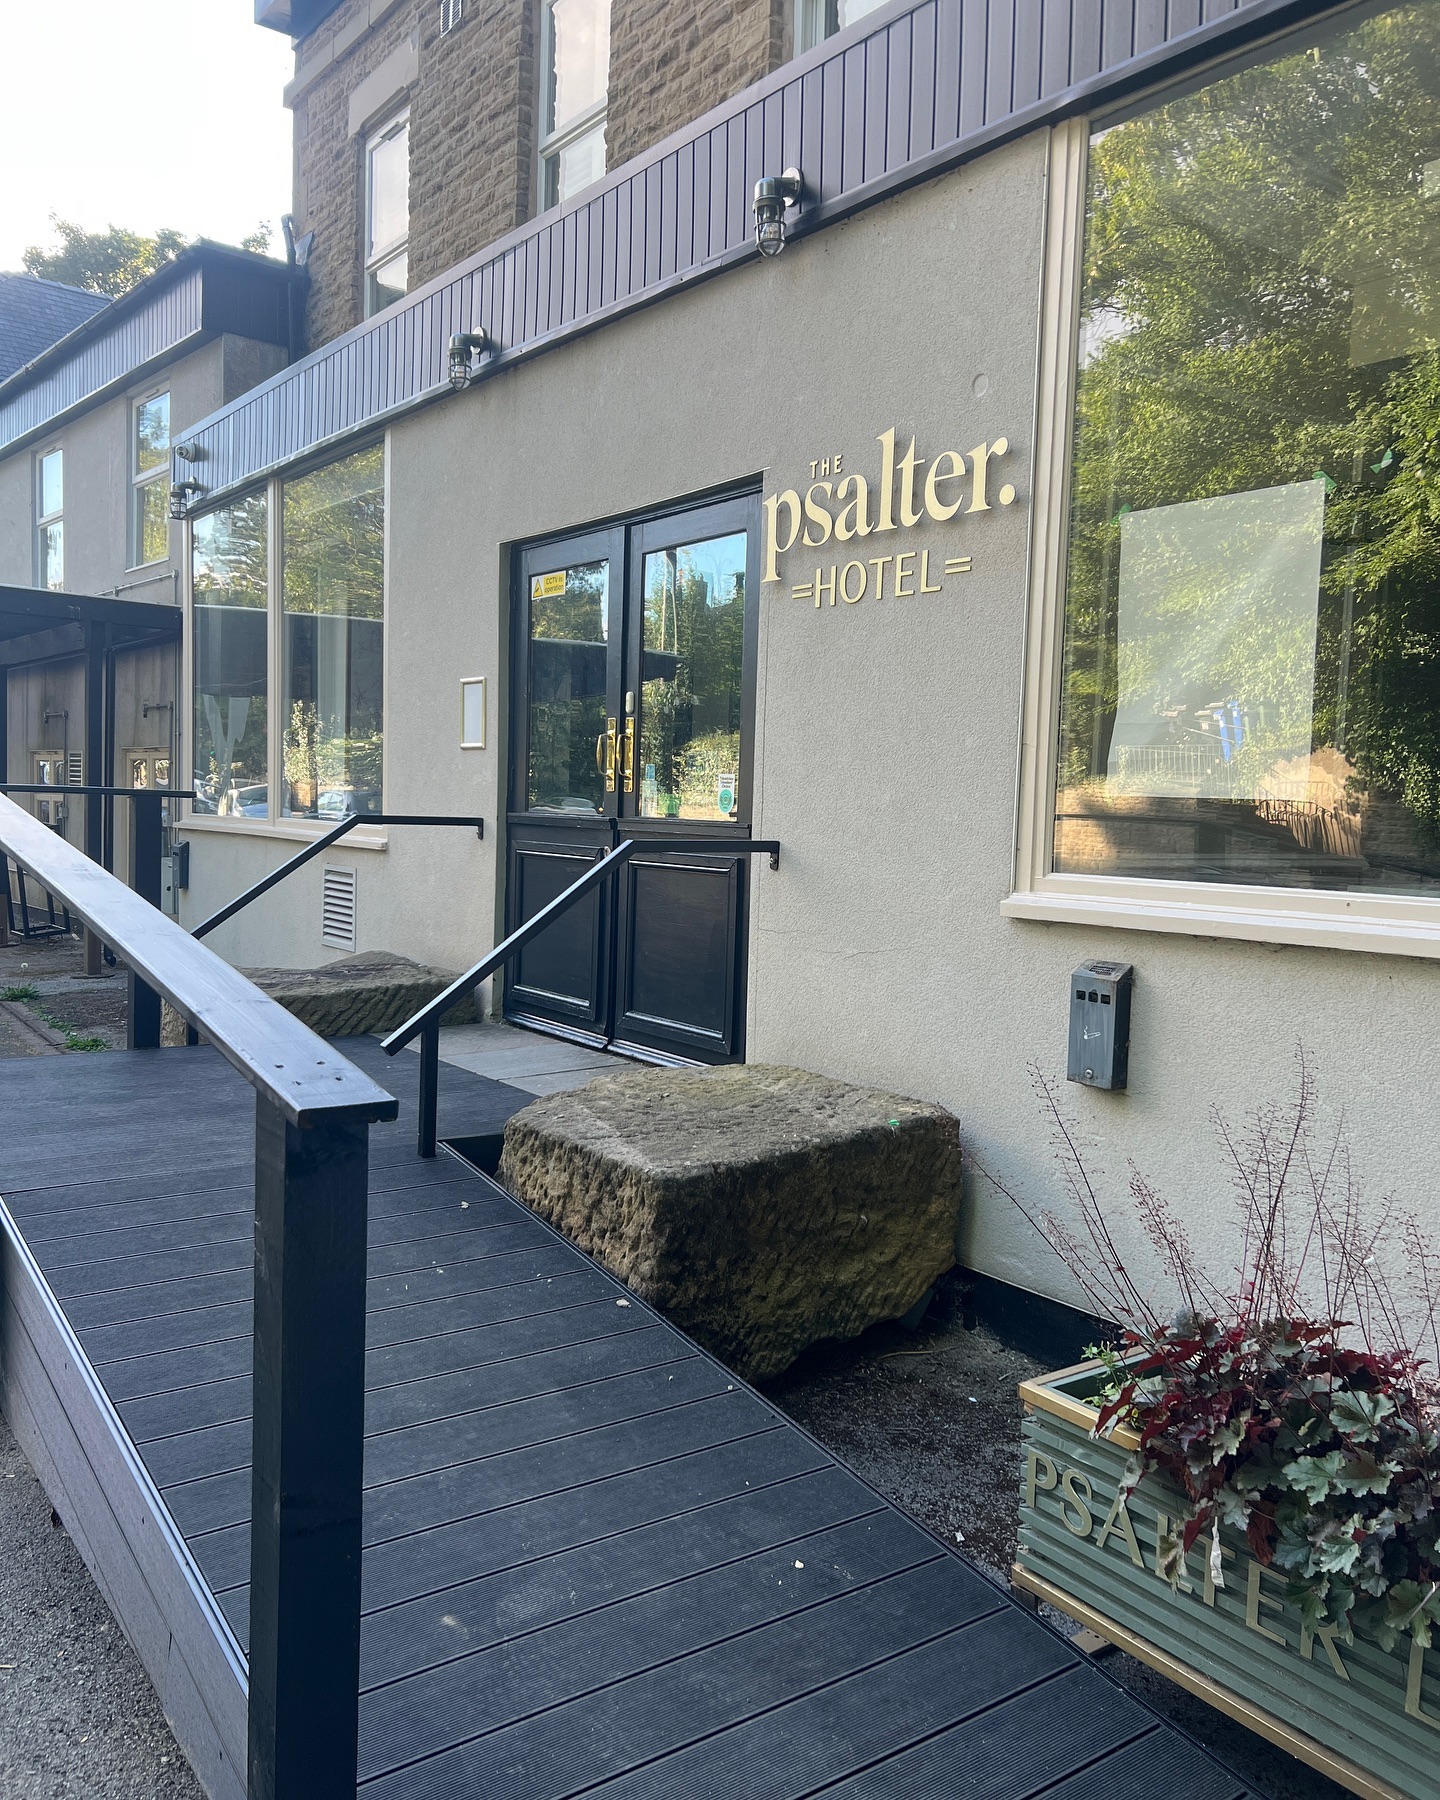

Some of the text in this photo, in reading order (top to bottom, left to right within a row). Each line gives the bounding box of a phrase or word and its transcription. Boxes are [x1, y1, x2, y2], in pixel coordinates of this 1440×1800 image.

[809, 454, 843, 479] THE
[761, 426, 1016, 583] psalter.
[546, 576, 558, 585] CCTV
